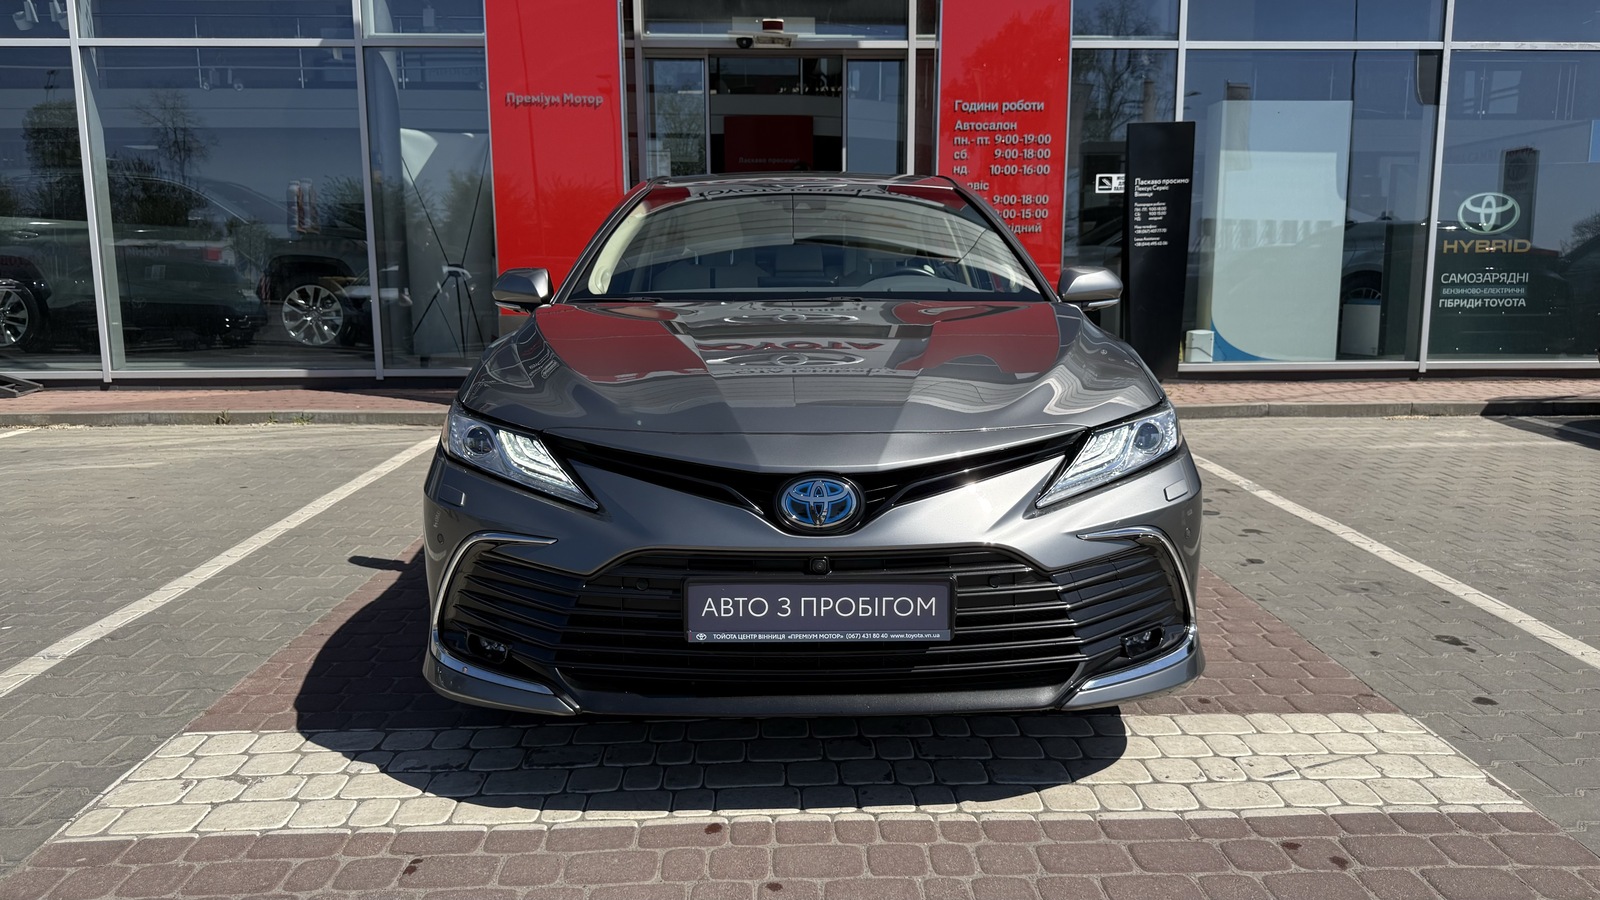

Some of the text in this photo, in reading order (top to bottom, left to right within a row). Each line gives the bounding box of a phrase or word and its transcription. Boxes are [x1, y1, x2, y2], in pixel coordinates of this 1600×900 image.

[506, 92, 604, 106] Преміум Мотор
[954, 99, 1045, 114] Години роботи
[954, 120, 1018, 131] Автосалон
[994, 134, 1052, 145] 9:00-19:00
[994, 148, 1051, 160] 9:00-18:00
[989, 164, 1051, 175] 10:00-16:00
[993, 194, 1049, 205] 9:00-18:00
[1442, 239, 1532, 254] HYBRID
[1440, 272, 1529, 284] САМОЗАРЯДНІ
[1442, 287, 1525, 295] БЕНЗИНОВО-ЕЛЕКТРИЧНІ
[1438, 298, 1527, 309] ГІБРИДИ TOYOTA
[701, 597, 769, 617] АВТО
[800, 596, 936, 617] ПРОБІГОМ
[712, 632, 738, 640] ТОЙОТА
[737, 633, 758, 641] ЦЕНТР
[758, 633, 785, 641] ВІННИЦЯ
[819, 632, 844, 640] МОТОР»
[845, 632, 861, 640] (067)
[890, 632, 940, 640] www.toyota.vn.ua
